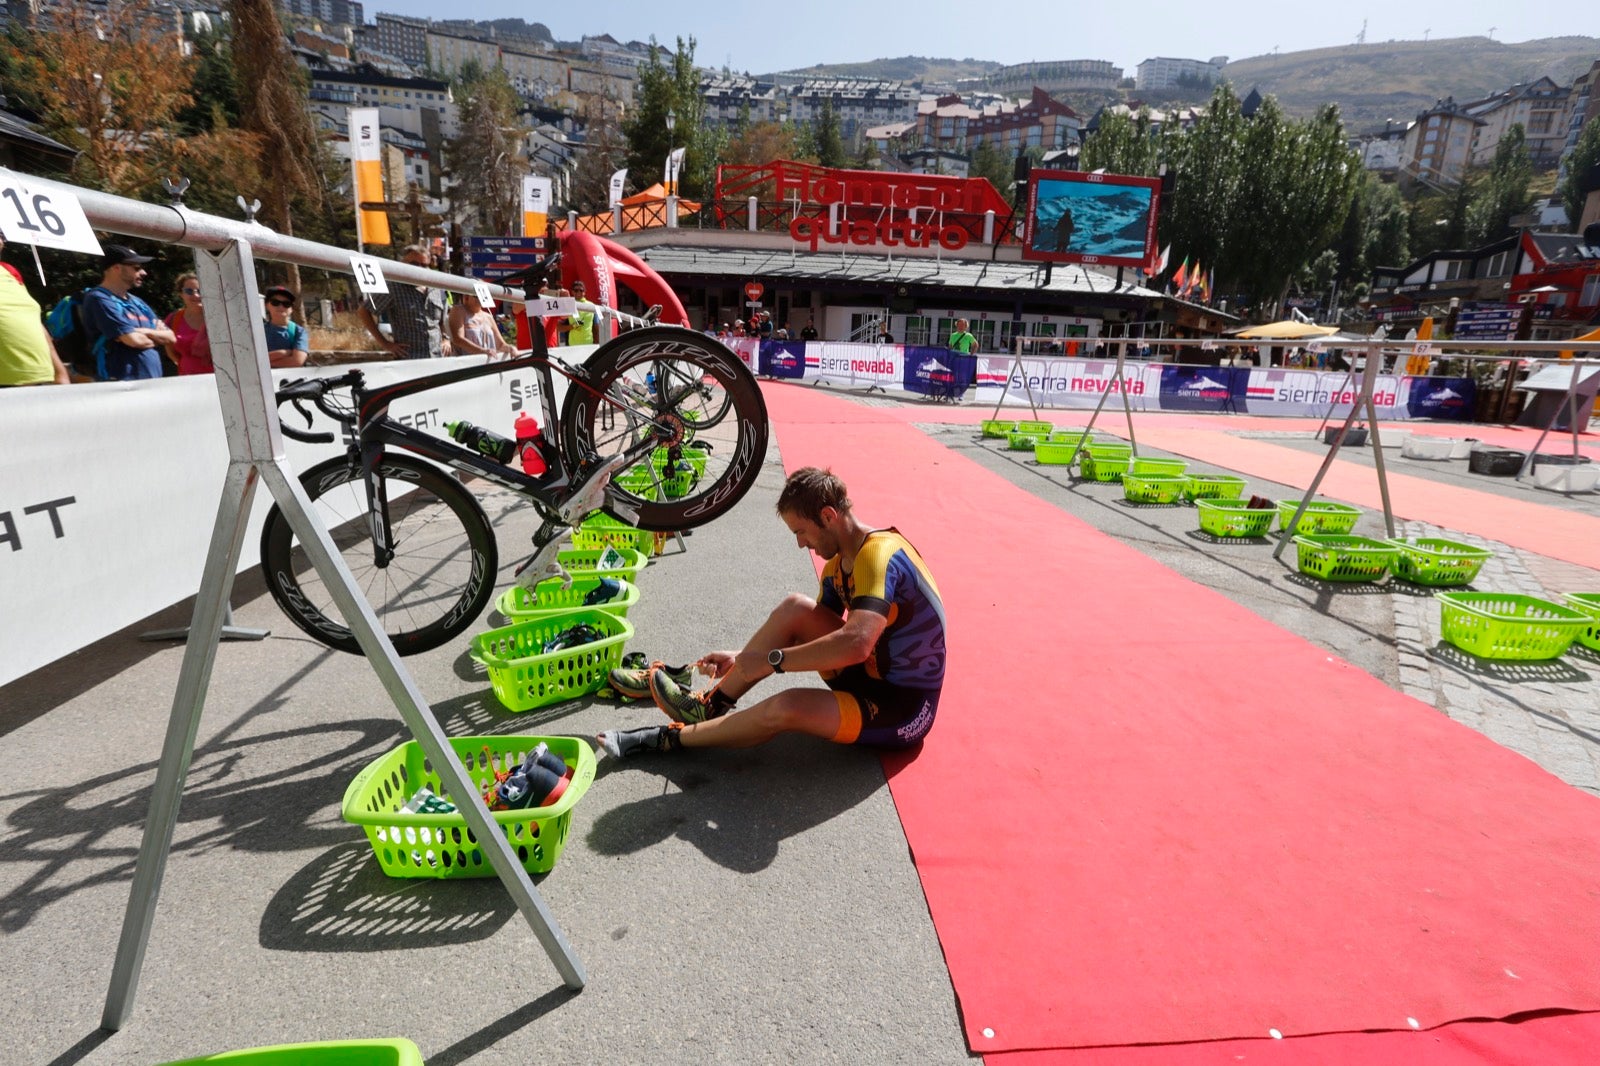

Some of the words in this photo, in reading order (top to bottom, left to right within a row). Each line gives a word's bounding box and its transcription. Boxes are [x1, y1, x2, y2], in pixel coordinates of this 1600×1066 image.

[775, 166, 920, 206] Home
[934, 181, 984, 213] of
[2, 187, 66, 236] 16
[789, 215, 969, 251] quattro
[358, 263, 376, 286] 15
[546, 300, 559, 311] 14
[615, 341, 737, 380] ZIPP
[1417, 344, 1428, 353] 67
[822, 356, 849, 371] sierra
[851, 357, 894, 375] nevada
[525, 384, 538, 398] SE
[1011, 371, 1067, 391] sierra
[1071, 376, 1145, 395] nevada
[1279, 385, 1328, 404] sierra
[399, 408, 439, 430] EAT
[319, 465, 421, 493] ZIP
[684, 419, 756, 517] ZIPP
[444, 549, 486, 629] ZIPP
[277, 571, 351, 640] ZIPP
[897, 699, 931, 736] ECOSPORT
